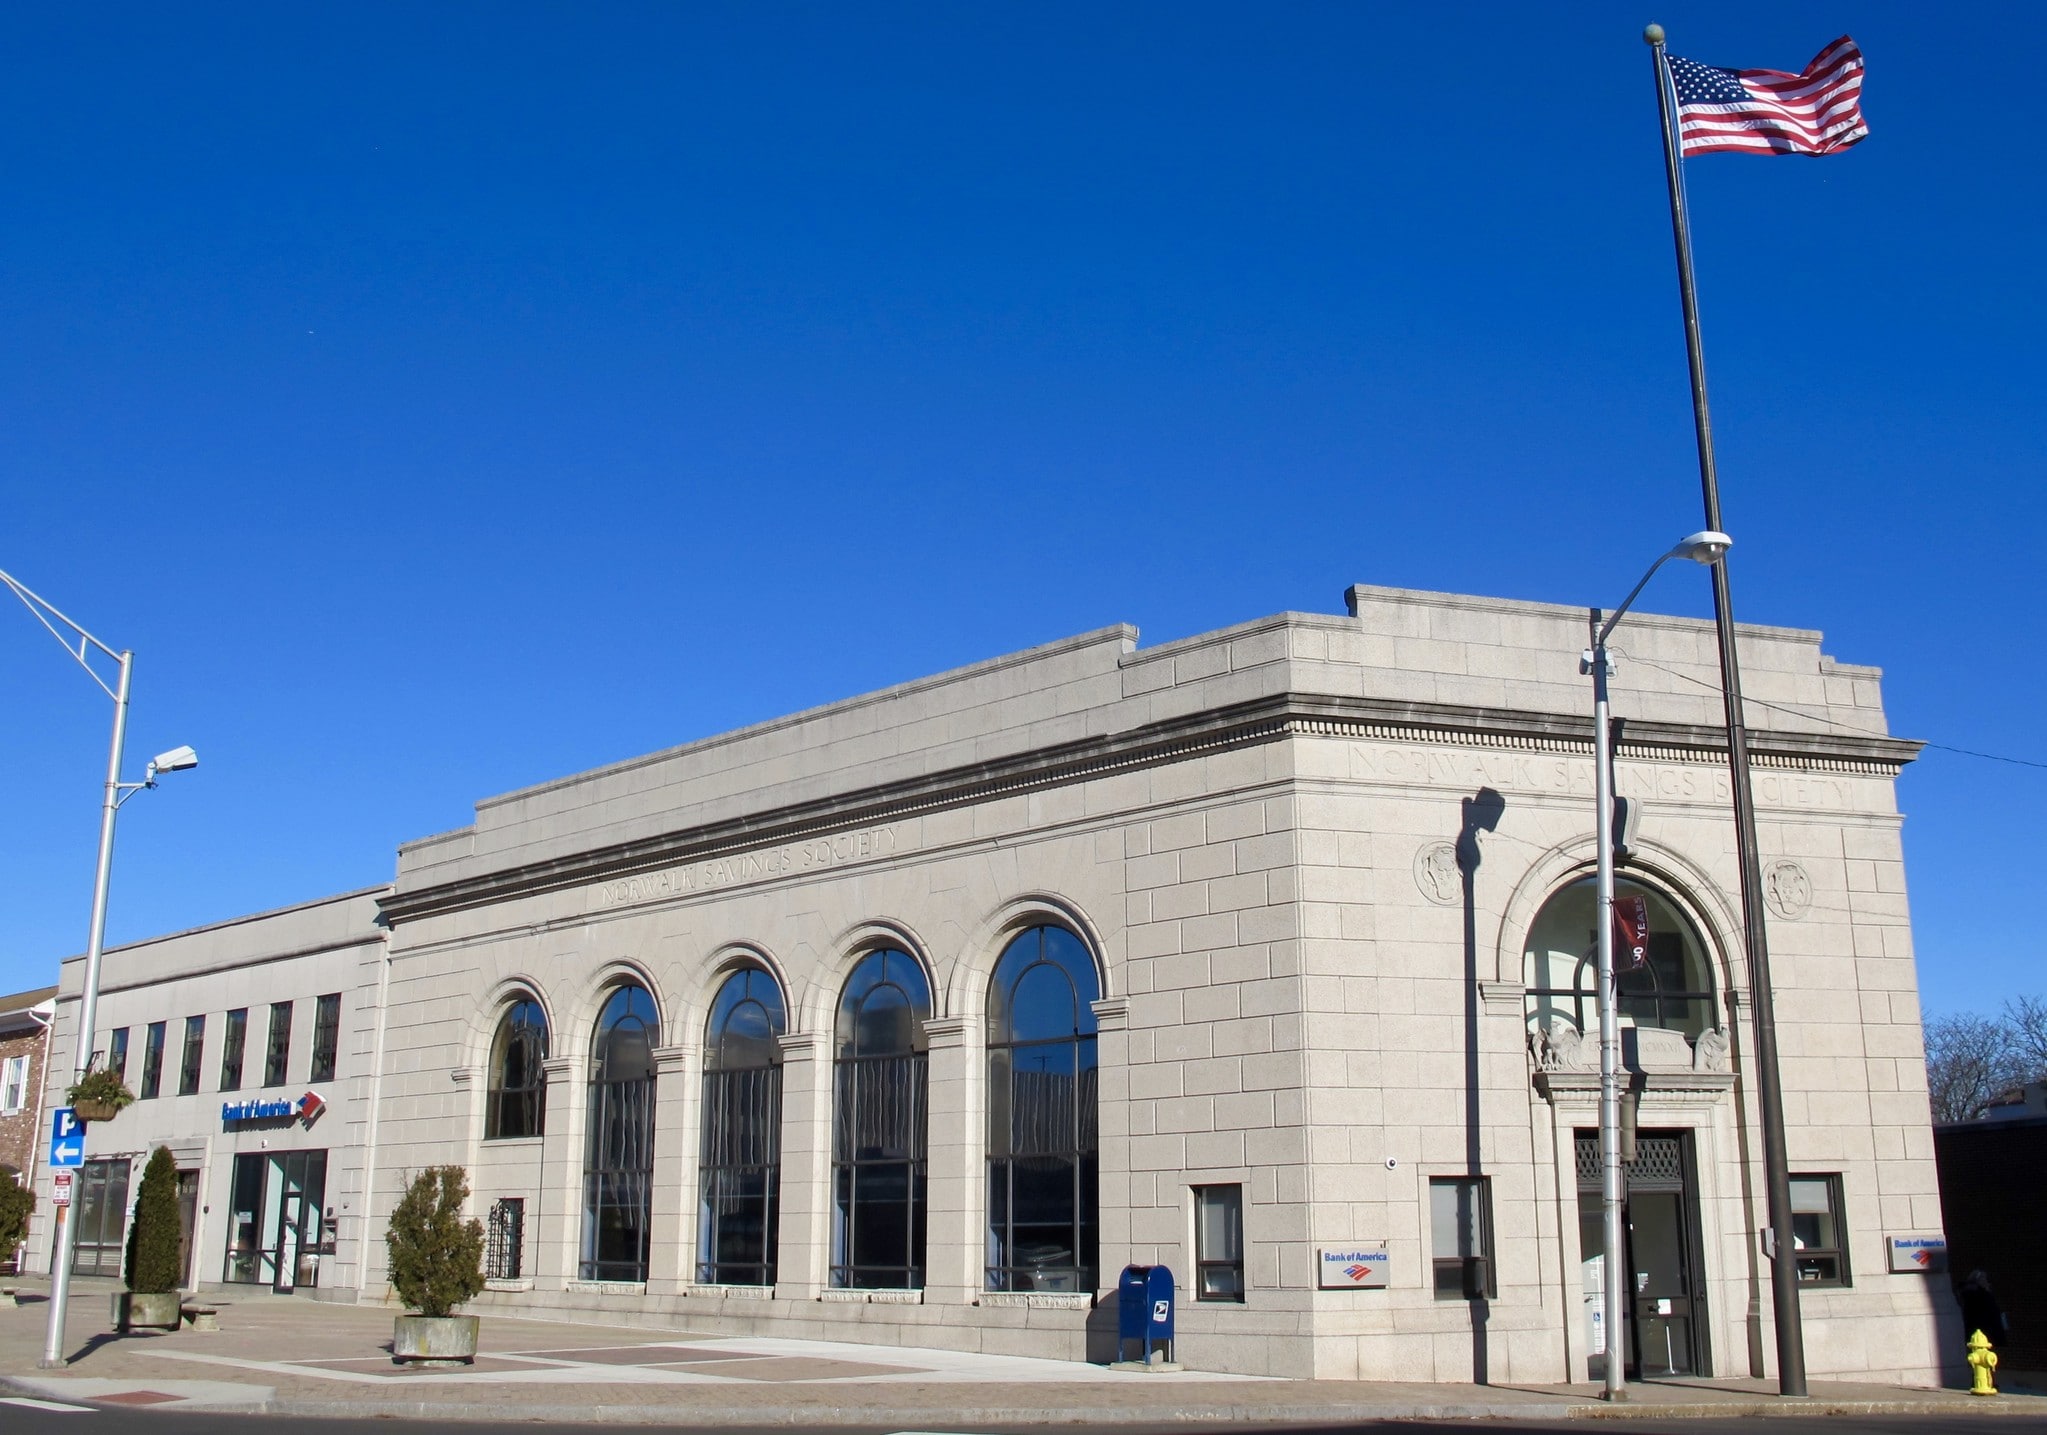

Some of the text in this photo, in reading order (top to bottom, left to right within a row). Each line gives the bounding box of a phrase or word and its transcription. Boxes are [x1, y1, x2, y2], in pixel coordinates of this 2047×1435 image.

[1353, 746, 1852, 807] NORWALK SAINGS SCIETY
[601, 825, 900, 905] NORWALK SAVINGS SOCIETY
[1633, 896, 1647, 941] YEARS
[222, 1097, 293, 1120] Bank of America
[60, 1112, 76, 1137] P
[1894, 1238, 1945, 1248] Bank of America
[1324, 1252, 1388, 1262] Bank of America
